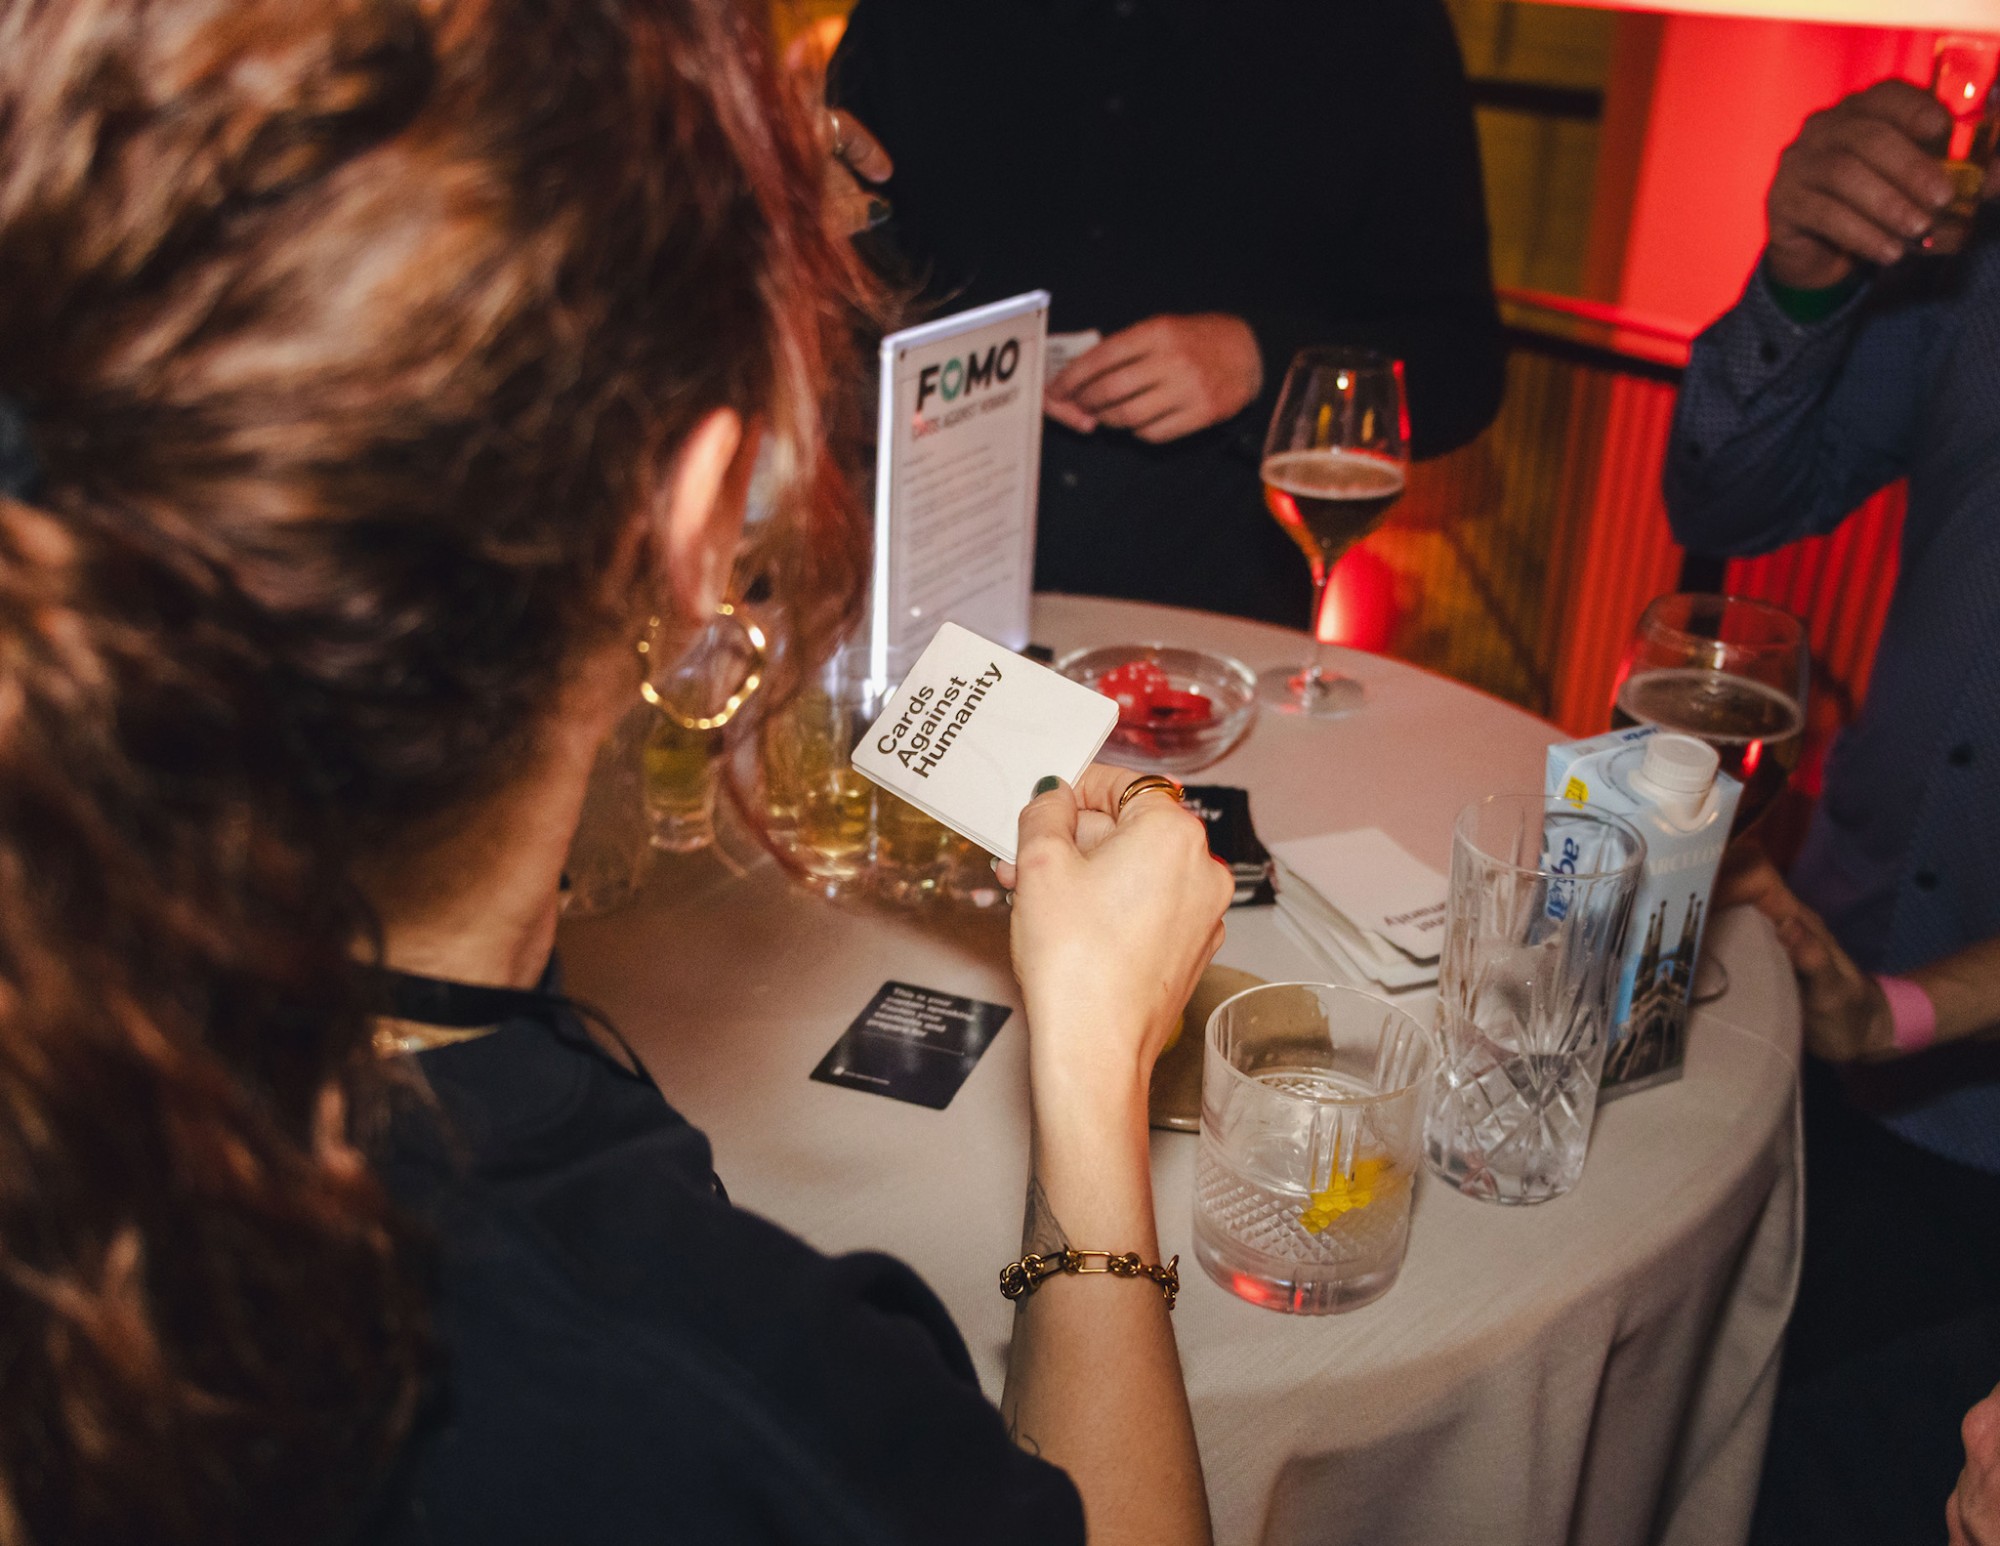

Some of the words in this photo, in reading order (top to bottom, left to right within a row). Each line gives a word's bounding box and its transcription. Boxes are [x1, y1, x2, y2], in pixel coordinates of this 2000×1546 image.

[915, 338, 1020, 413] FOMO
[877, 685, 935, 755] Cards
[896, 676, 967, 769] Against
[912, 662, 1003, 779] Humanity
